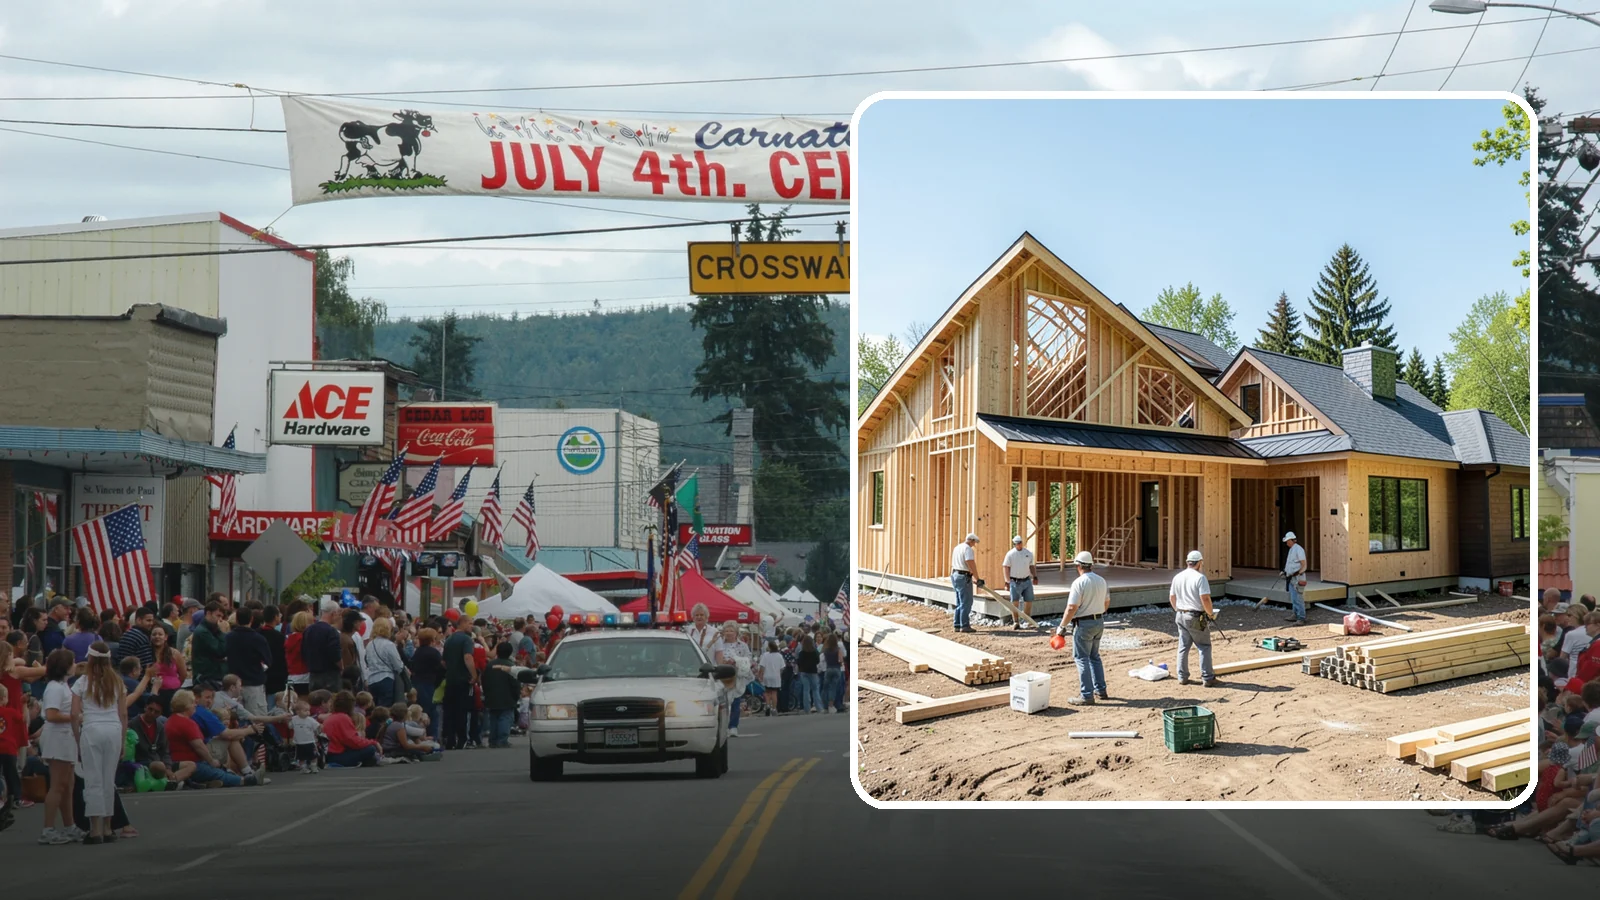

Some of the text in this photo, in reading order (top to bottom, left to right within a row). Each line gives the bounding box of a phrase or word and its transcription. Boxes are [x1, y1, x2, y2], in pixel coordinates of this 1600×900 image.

[694, 121, 850, 150] Carnat
[481, 141, 605, 192] JULY
[632, 150, 746, 197] 4th.
[697, 254, 850, 280] CROSSWA
[283, 380, 373, 420] ACE
[405, 409, 485, 422] CEDAR LOG
[283, 421, 370, 436] Hardware
[416, 428, 477, 447] Coca-Cola
[353, 467, 386, 481] Simpl
[95, 485, 124, 495] Vincent
[126, 486, 136, 495] de
[137, 486, 155, 495] Paul
[81, 503, 154, 522] THT
[688, 526, 741, 535] CRNATION
[699, 535, 730, 543] GLASS
